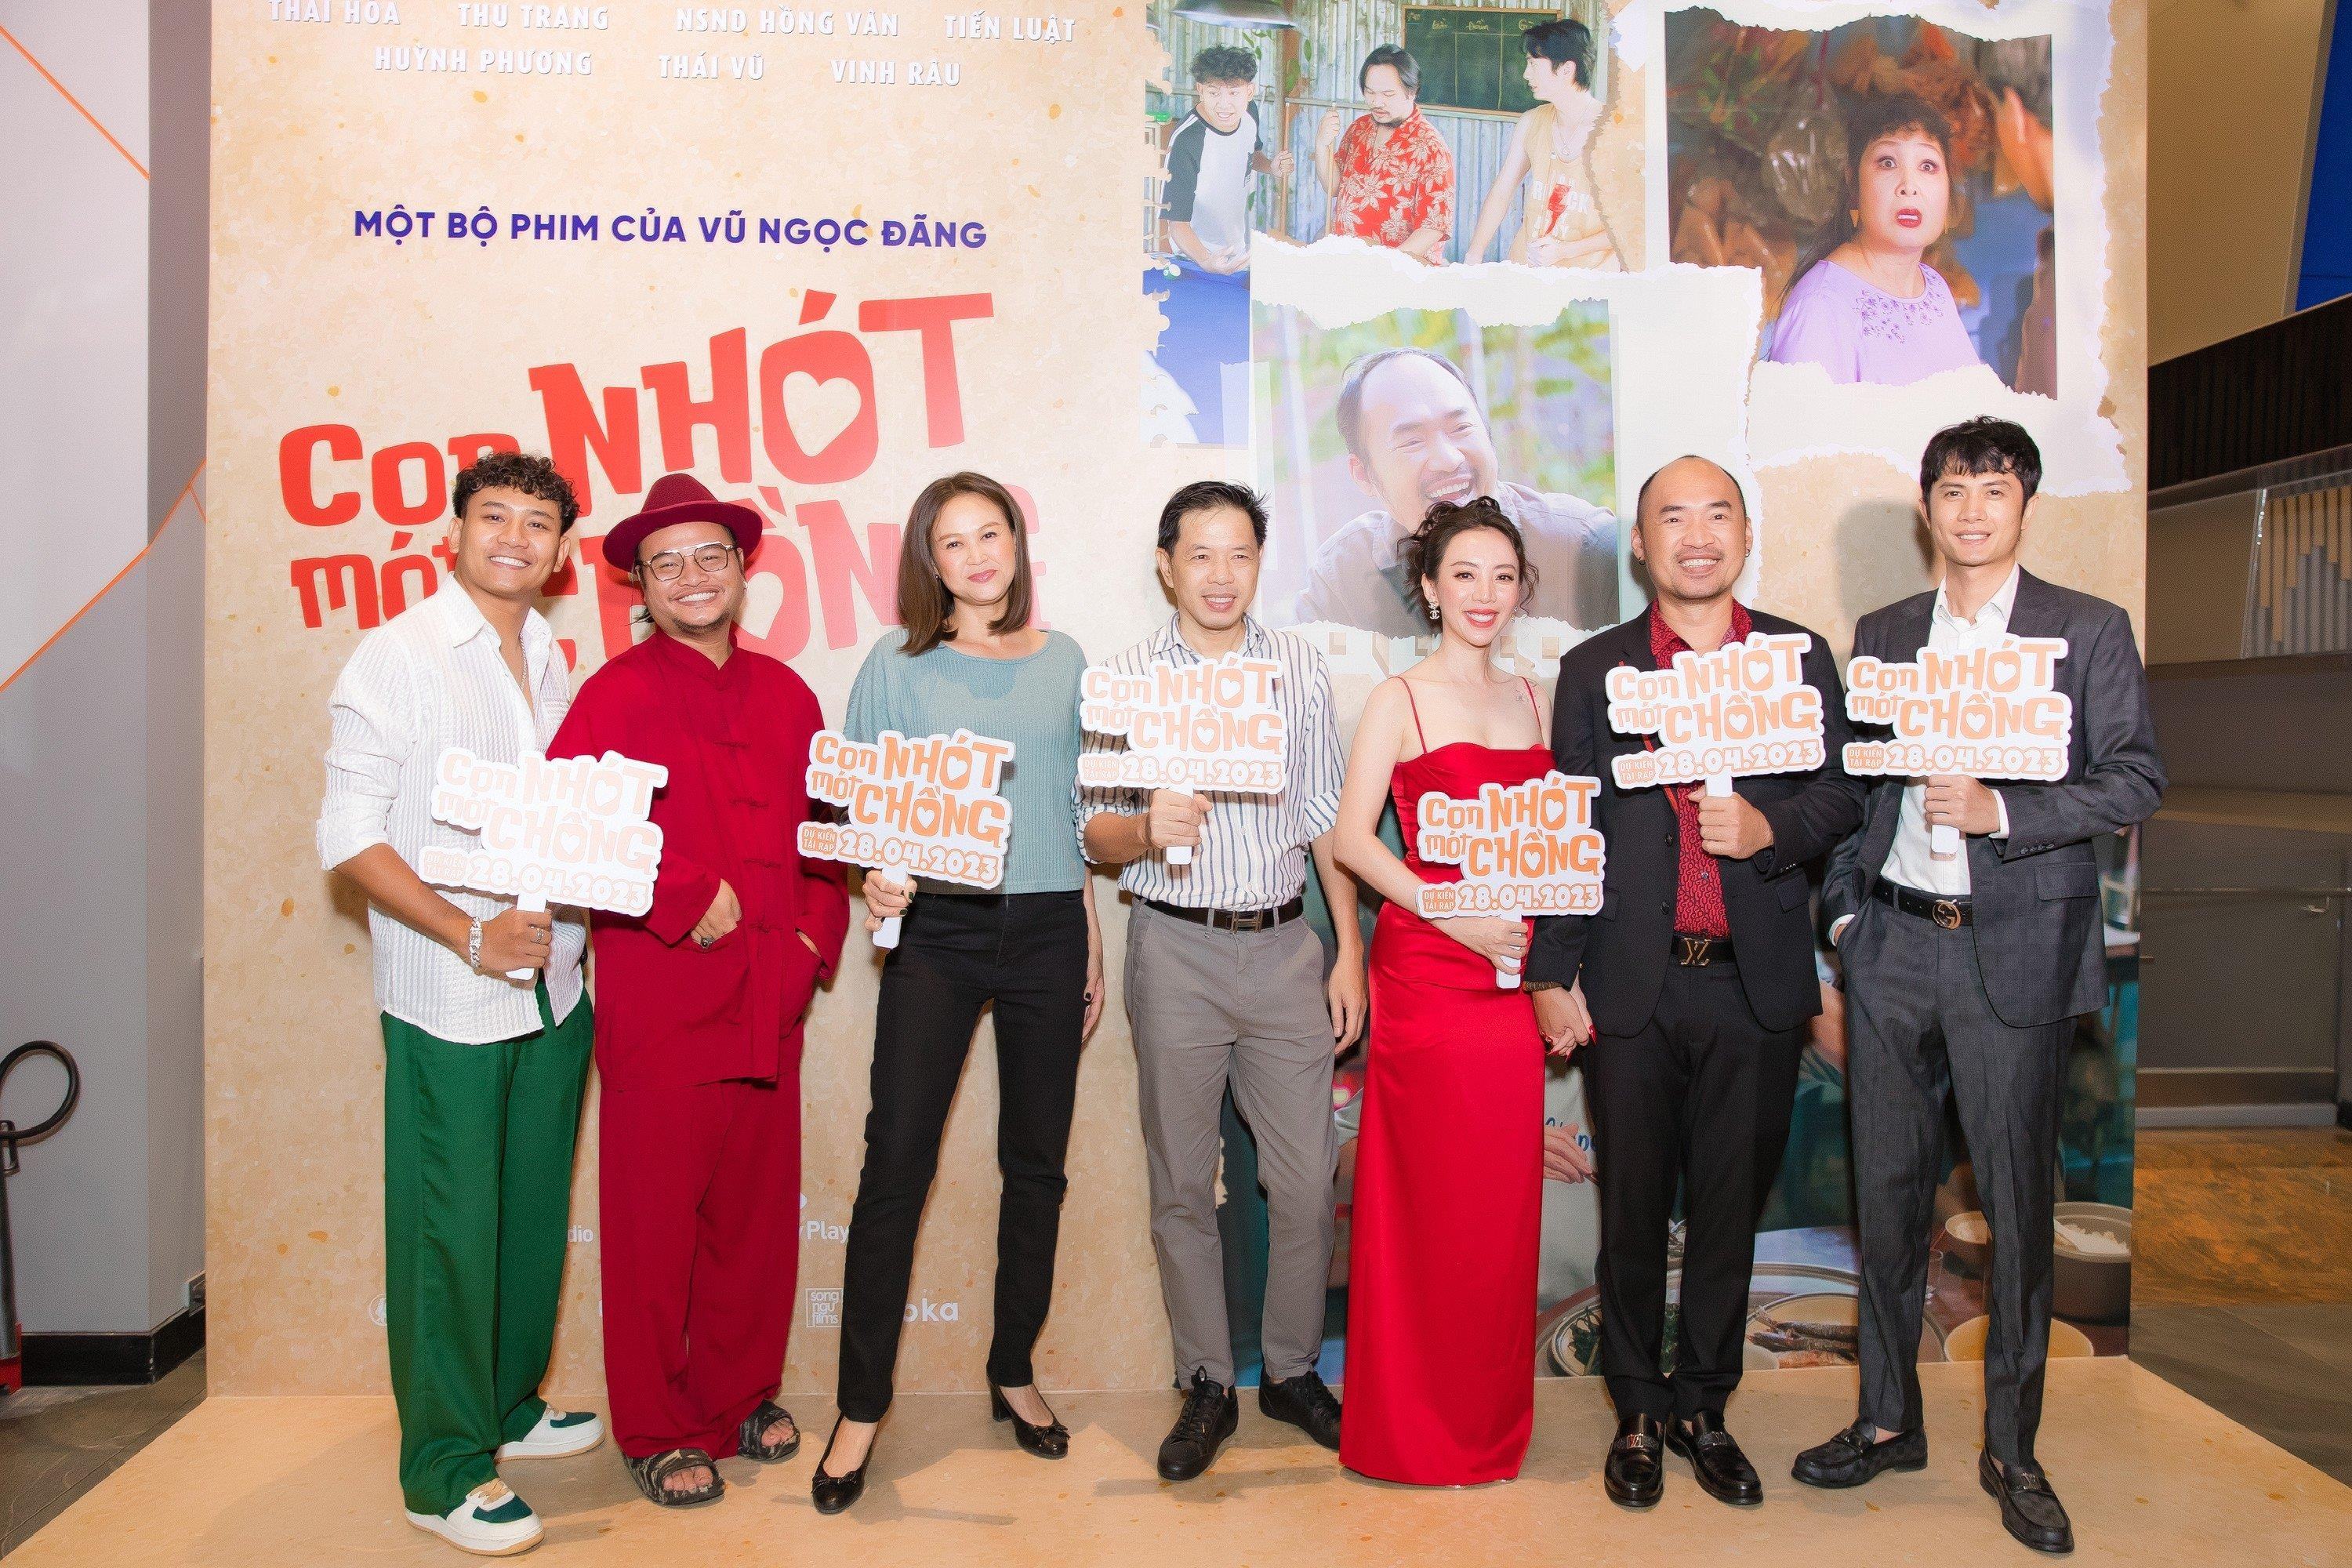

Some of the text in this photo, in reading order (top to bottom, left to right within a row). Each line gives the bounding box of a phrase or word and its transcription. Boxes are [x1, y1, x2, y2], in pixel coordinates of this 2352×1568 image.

[458, 3, 609, 31] THU TRANG
[675, 3, 899, 37] NSND HỒNG VÂN
[944, 9, 1076, 45] TIẾN LUẬT
[480, 48, 593, 75] PHƯƠNG
[658, 50, 765, 81] THÁI VŨ
[829, 56, 961, 87] VINH RÂU
[354, 204, 988, 253] MỘT BỘ PHIM CỦA VŨ NGỌC ĐÃNG
[528, 288, 995, 517] NHÓT
[1156, 658, 1278, 709] NHÓT
[1680, 639, 1805, 699] NHÓT
[1923, 639, 2060, 695] NHÓT
[1134, 705, 1283, 755] CHỒNG
[1664, 691, 1818, 744] CHỒNG
[1899, 691, 2064, 740] CHỒNG
[883, 735, 1008, 790] NHÓT
[1121, 755, 1282, 789] 28.04.2023
[1656, 739, 1821, 779] 28.04.2023
[1886, 744, 2063, 775] 28.04.2023
[518, 756, 662, 816] NHÓT
[1486, 776, 1596, 833] NHÓT
[855, 781, 1006, 849] CHỒNG
[488, 805, 658, 876] CHỒNG
[837, 830, 999, 884] 28.04.2023
[1468, 829, 1601, 879] CHỒNG
[466, 855, 649, 911] 28.04.2023
[1457, 883, 1600, 910] 28.04.2023
[807, 1219, 851, 1244] Play
